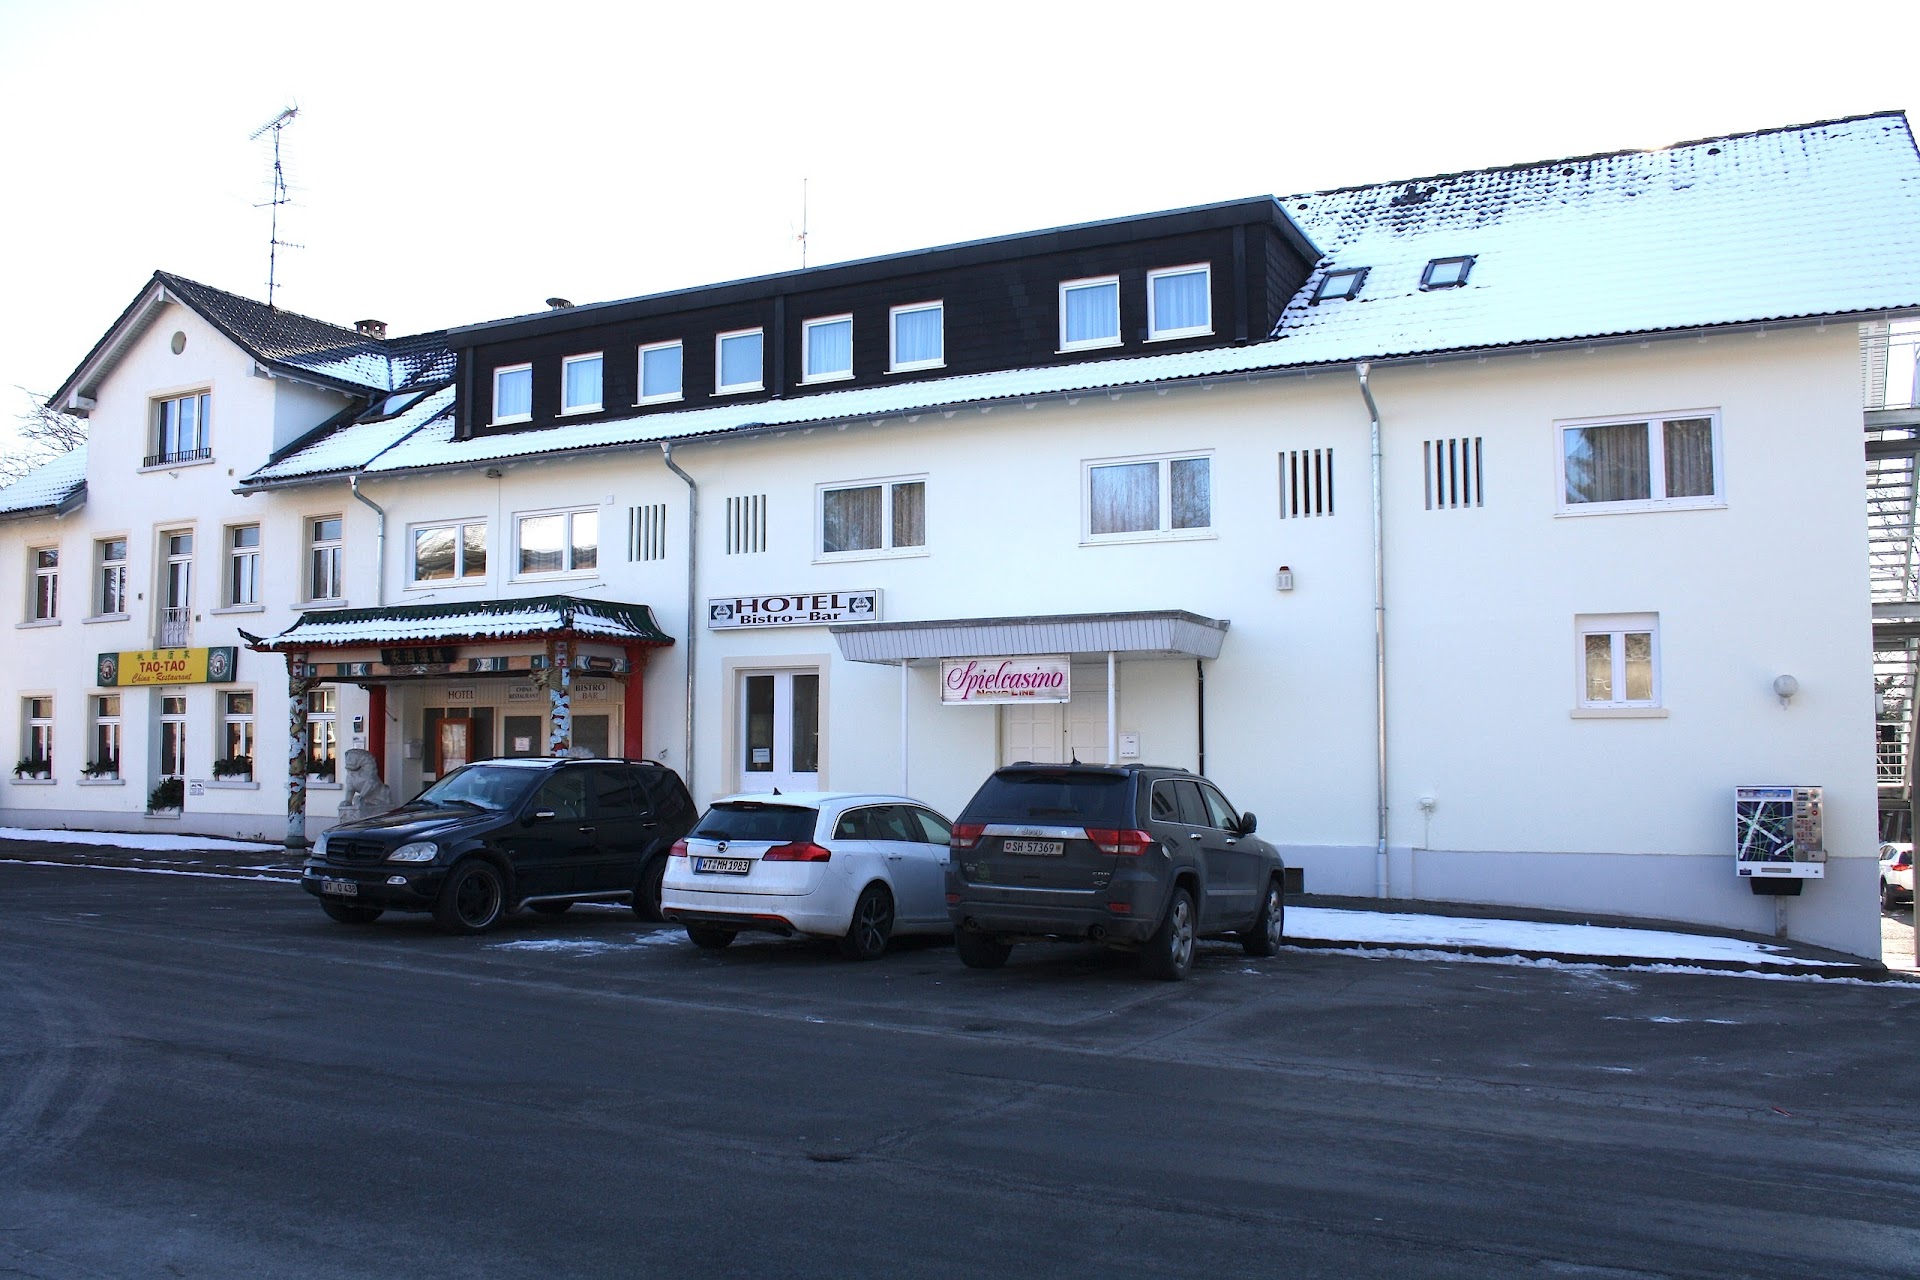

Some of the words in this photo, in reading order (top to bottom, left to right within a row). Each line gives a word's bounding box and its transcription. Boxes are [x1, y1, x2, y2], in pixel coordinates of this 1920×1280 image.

[735, 594, 847, 613] HOTEL
[140, 660, 186, 673] TAO-TAO
[947, 660, 1063, 699] Spielcasino
[575, 683, 606, 692] BISTRO
[448, 690, 475, 699] HOTEL
[1021, 827, 1043, 836] Jeep
[728, 861, 748, 871] 1983
